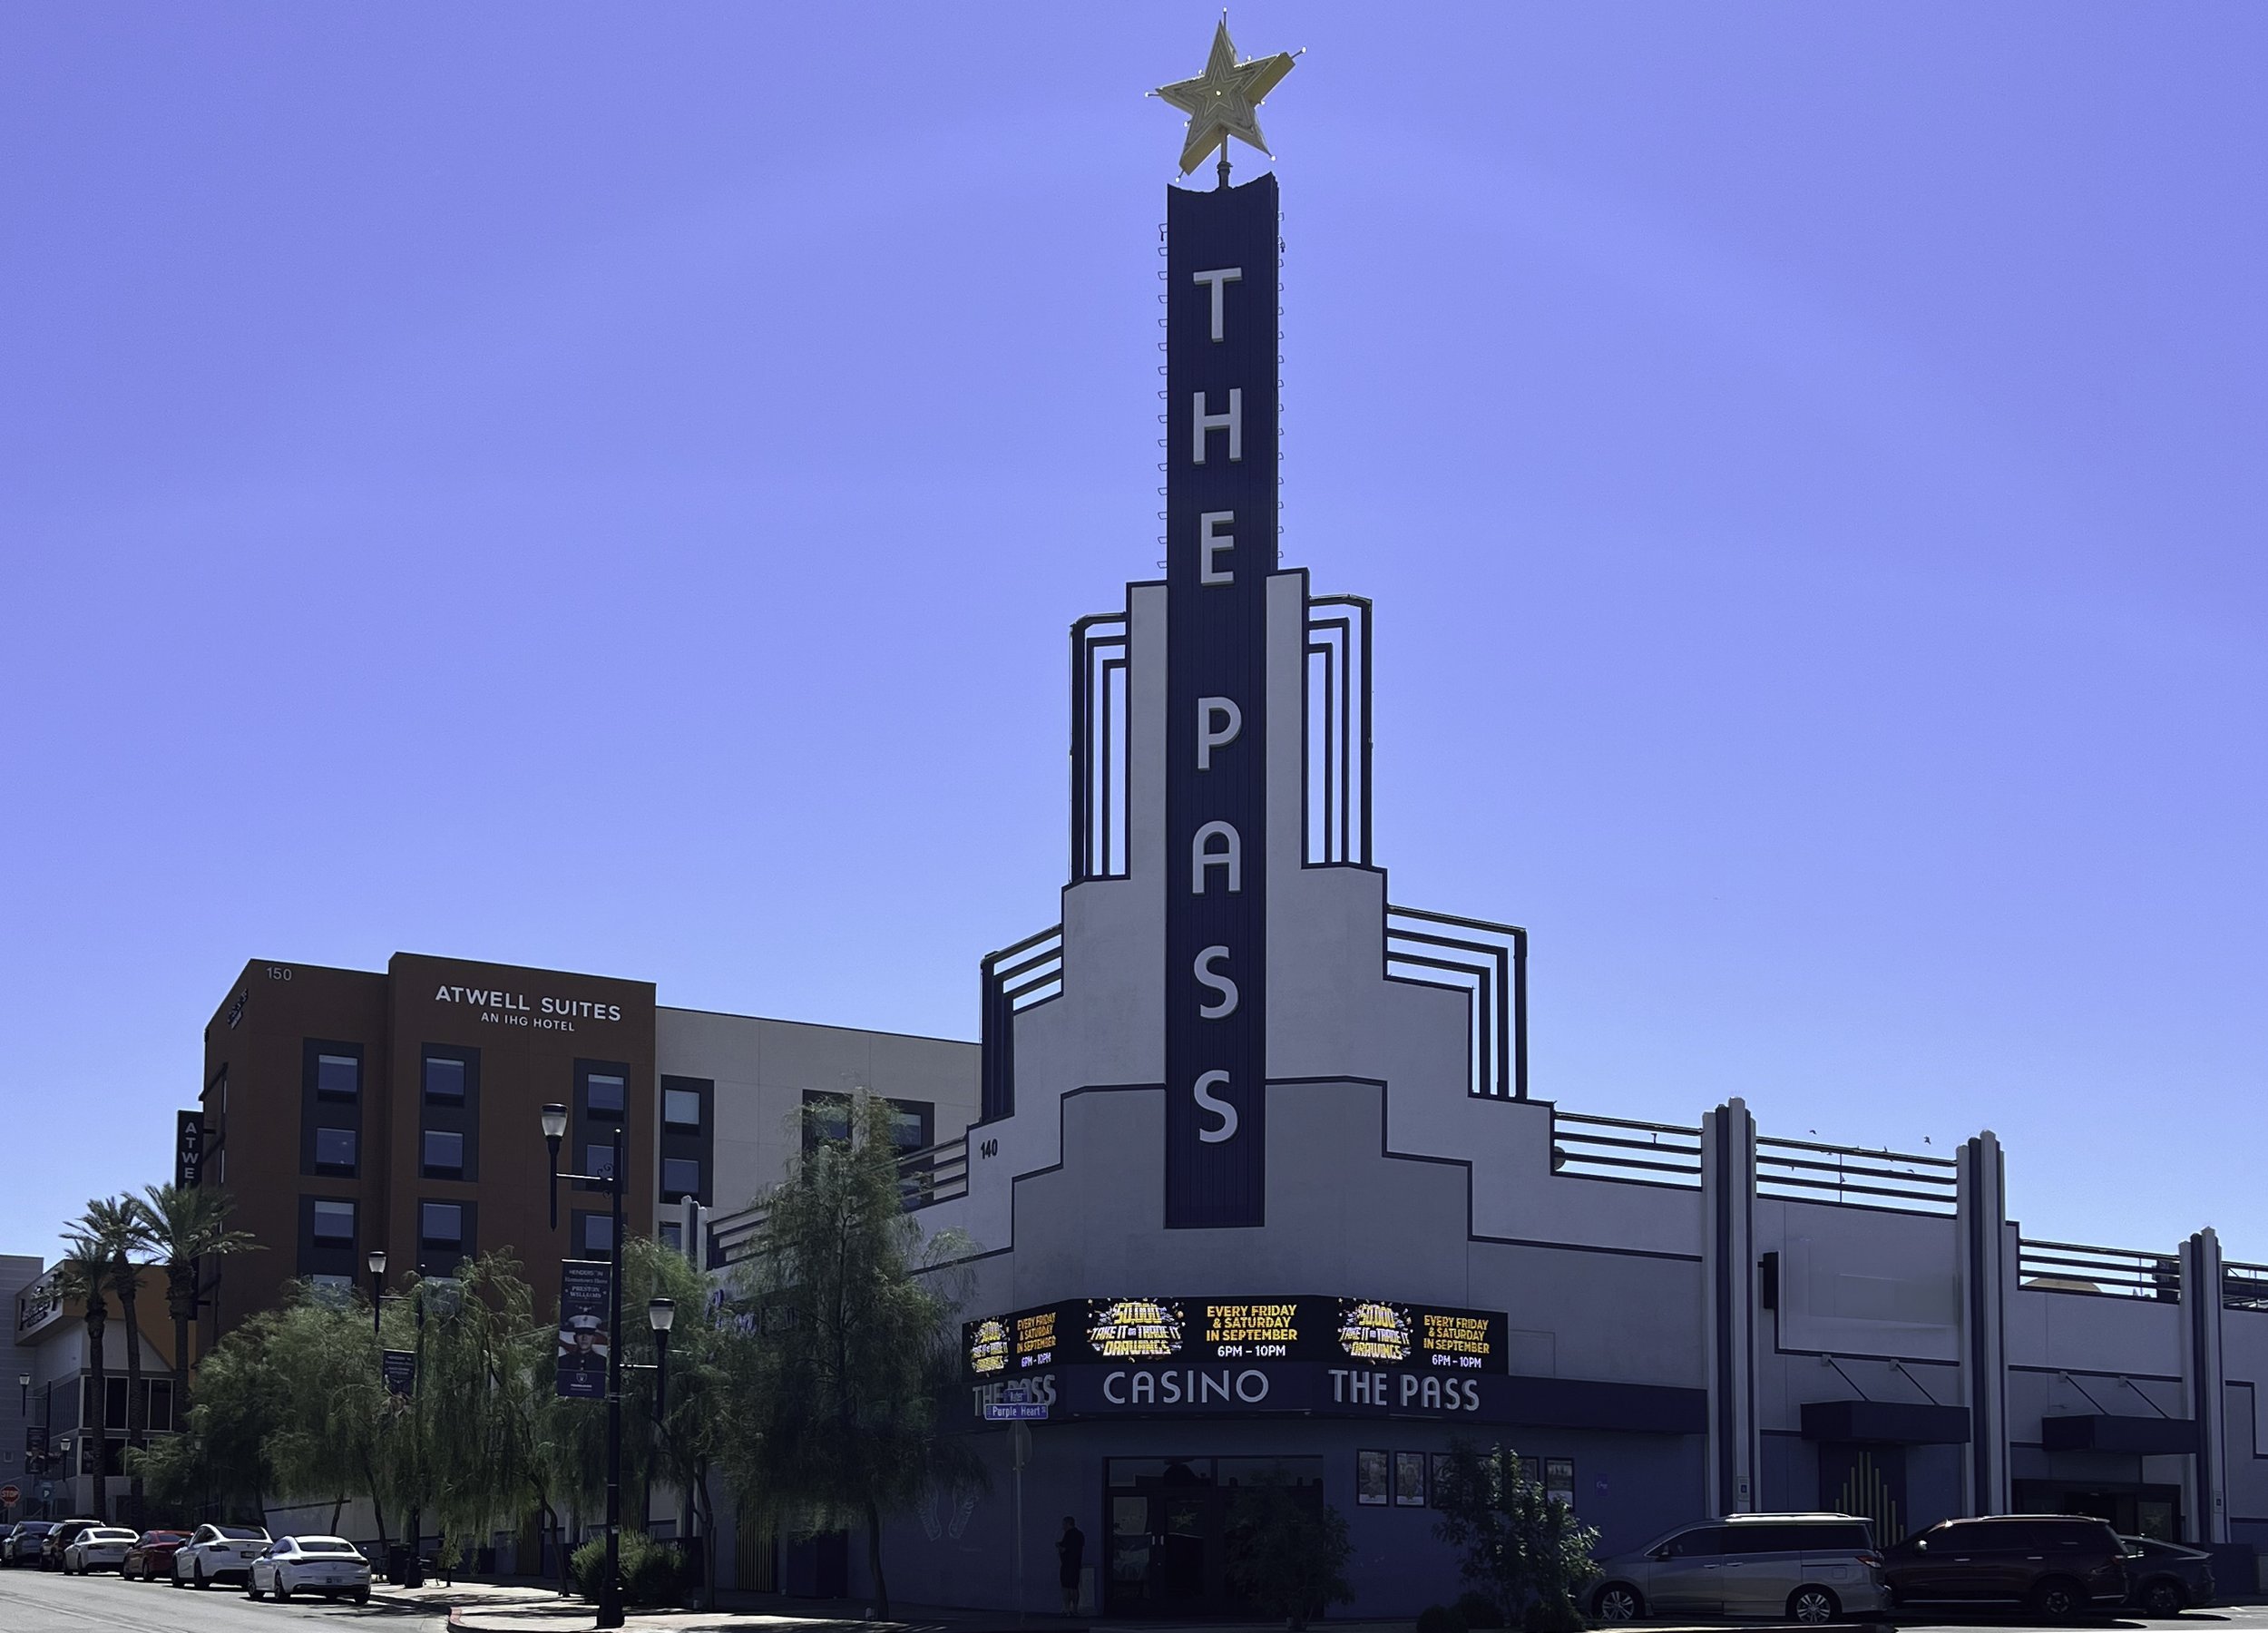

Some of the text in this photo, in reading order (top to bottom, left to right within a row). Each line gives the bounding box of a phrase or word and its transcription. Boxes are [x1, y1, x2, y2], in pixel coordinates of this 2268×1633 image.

[1192, 267, 1243, 1144] THE PASS
[267, 966, 292, 981] 150
[435, 985, 621, 1022] ATWELL SUITES
[481, 1012, 574, 1032] AN IHG HOTEL
[981, 1139, 998, 1159] 140
[1207, 1305, 1297, 1317] EVERY FRIDAY
[1213, 1316, 1291, 1329] & SATURDAY
[1423, 1315, 1490, 1331] EVERY FRIDAY
[1206, 1328, 1297, 1342] IN SEPTEMBER
[1428, 1326, 1485, 1341] & SATURDAY
[1103, 1340, 1172, 1356] DRAWINGS
[1217, 1345, 1243, 1357] 6PM
[1256, 1345, 1286, 1356] 10PM
[1423, 1338, 1490, 1354] IN SEPTEMBER
[1432, 1354, 1451, 1367] 6PM
[1460, 1356, 1481, 1369] 10PM
[1103, 1369, 1269, 1404] CASINO
[1328, 1368, 1480, 1412] THE PASS
[992, 1405, 1017, 1419] Purple
[1021, 1405, 1041, 1416] Heart
[2, 1490, 19, 1498] STOP
